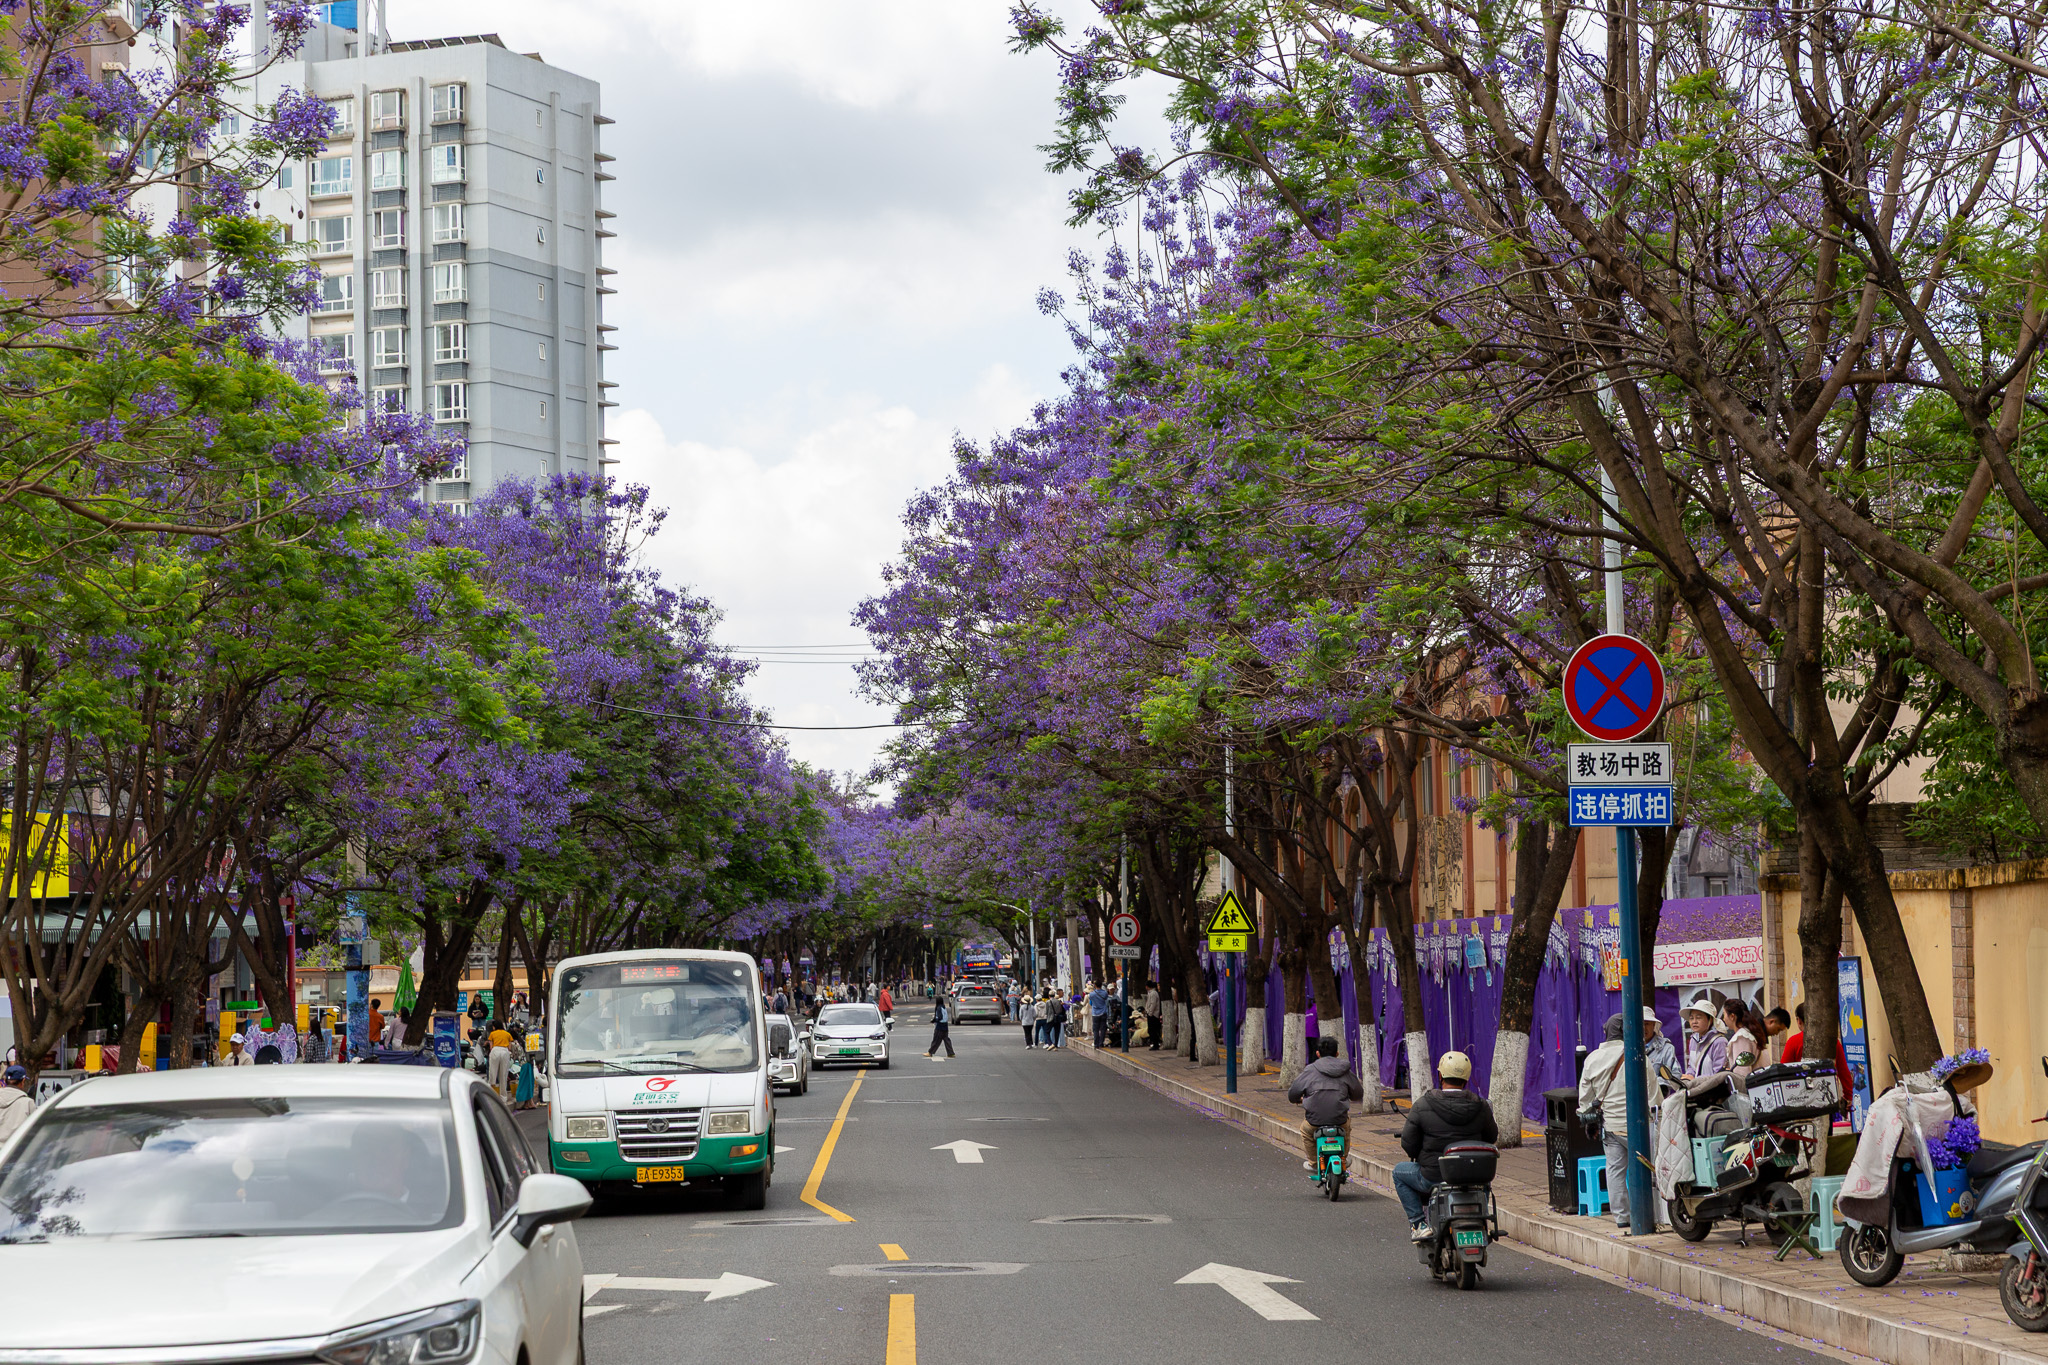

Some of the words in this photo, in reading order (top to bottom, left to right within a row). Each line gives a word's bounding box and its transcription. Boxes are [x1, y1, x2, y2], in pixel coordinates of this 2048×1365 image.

[1577, 751, 1662, 777] 教场中路
[1575, 792, 1667, 820] 违停抓拍
[1116, 921, 1133, 938] 15
[1215, 937, 1240, 947] 学校
[1653, 944, 1763, 971] 手工冰粉·冰汤
